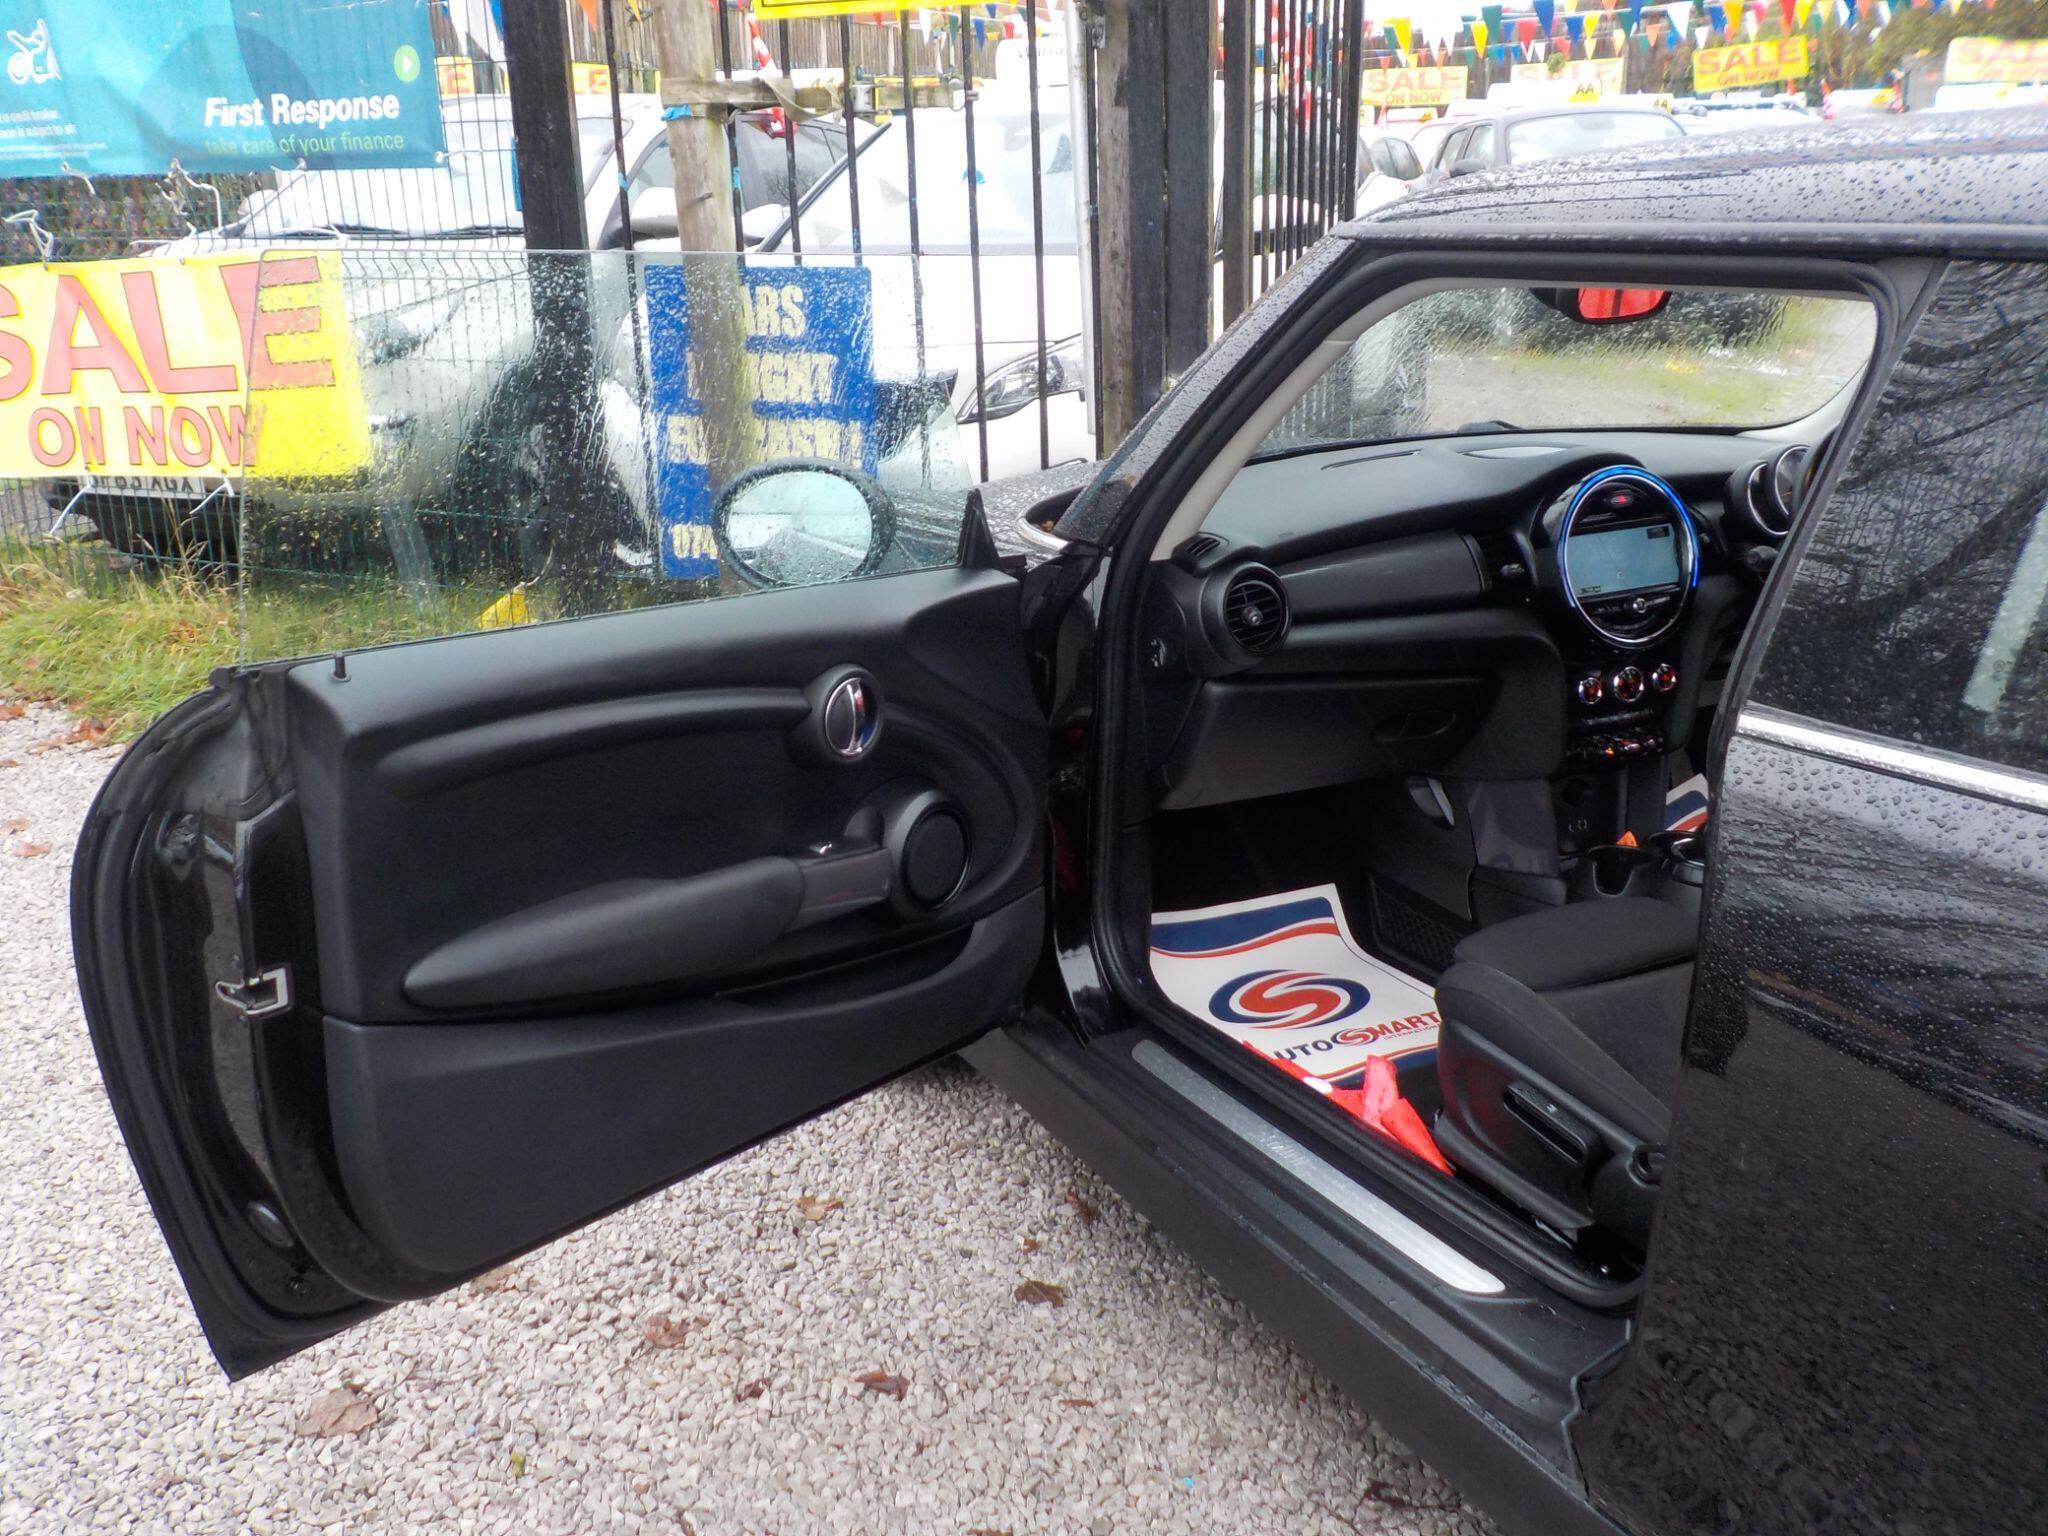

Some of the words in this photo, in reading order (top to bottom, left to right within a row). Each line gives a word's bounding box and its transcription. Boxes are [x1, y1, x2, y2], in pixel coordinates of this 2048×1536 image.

[1698, 37, 1801, 74] SALE
[1368, 70, 1461, 92] SALE
[1385, 94, 1405, 105] ON
[1409, 92, 1442, 103] NOW
[204, 97, 264, 127] First
[271, 93, 400, 129] Response
[206, 138, 237, 155] take
[243, 140, 275, 154] care
[279, 135, 295, 153] of
[299, 136, 336, 156] your
[340, 131, 404, 151] finance
[29, 406, 106, 467] ON
[123, 406, 257, 467] NOW
[1273, 1011, 1441, 1061] UTOSMART
